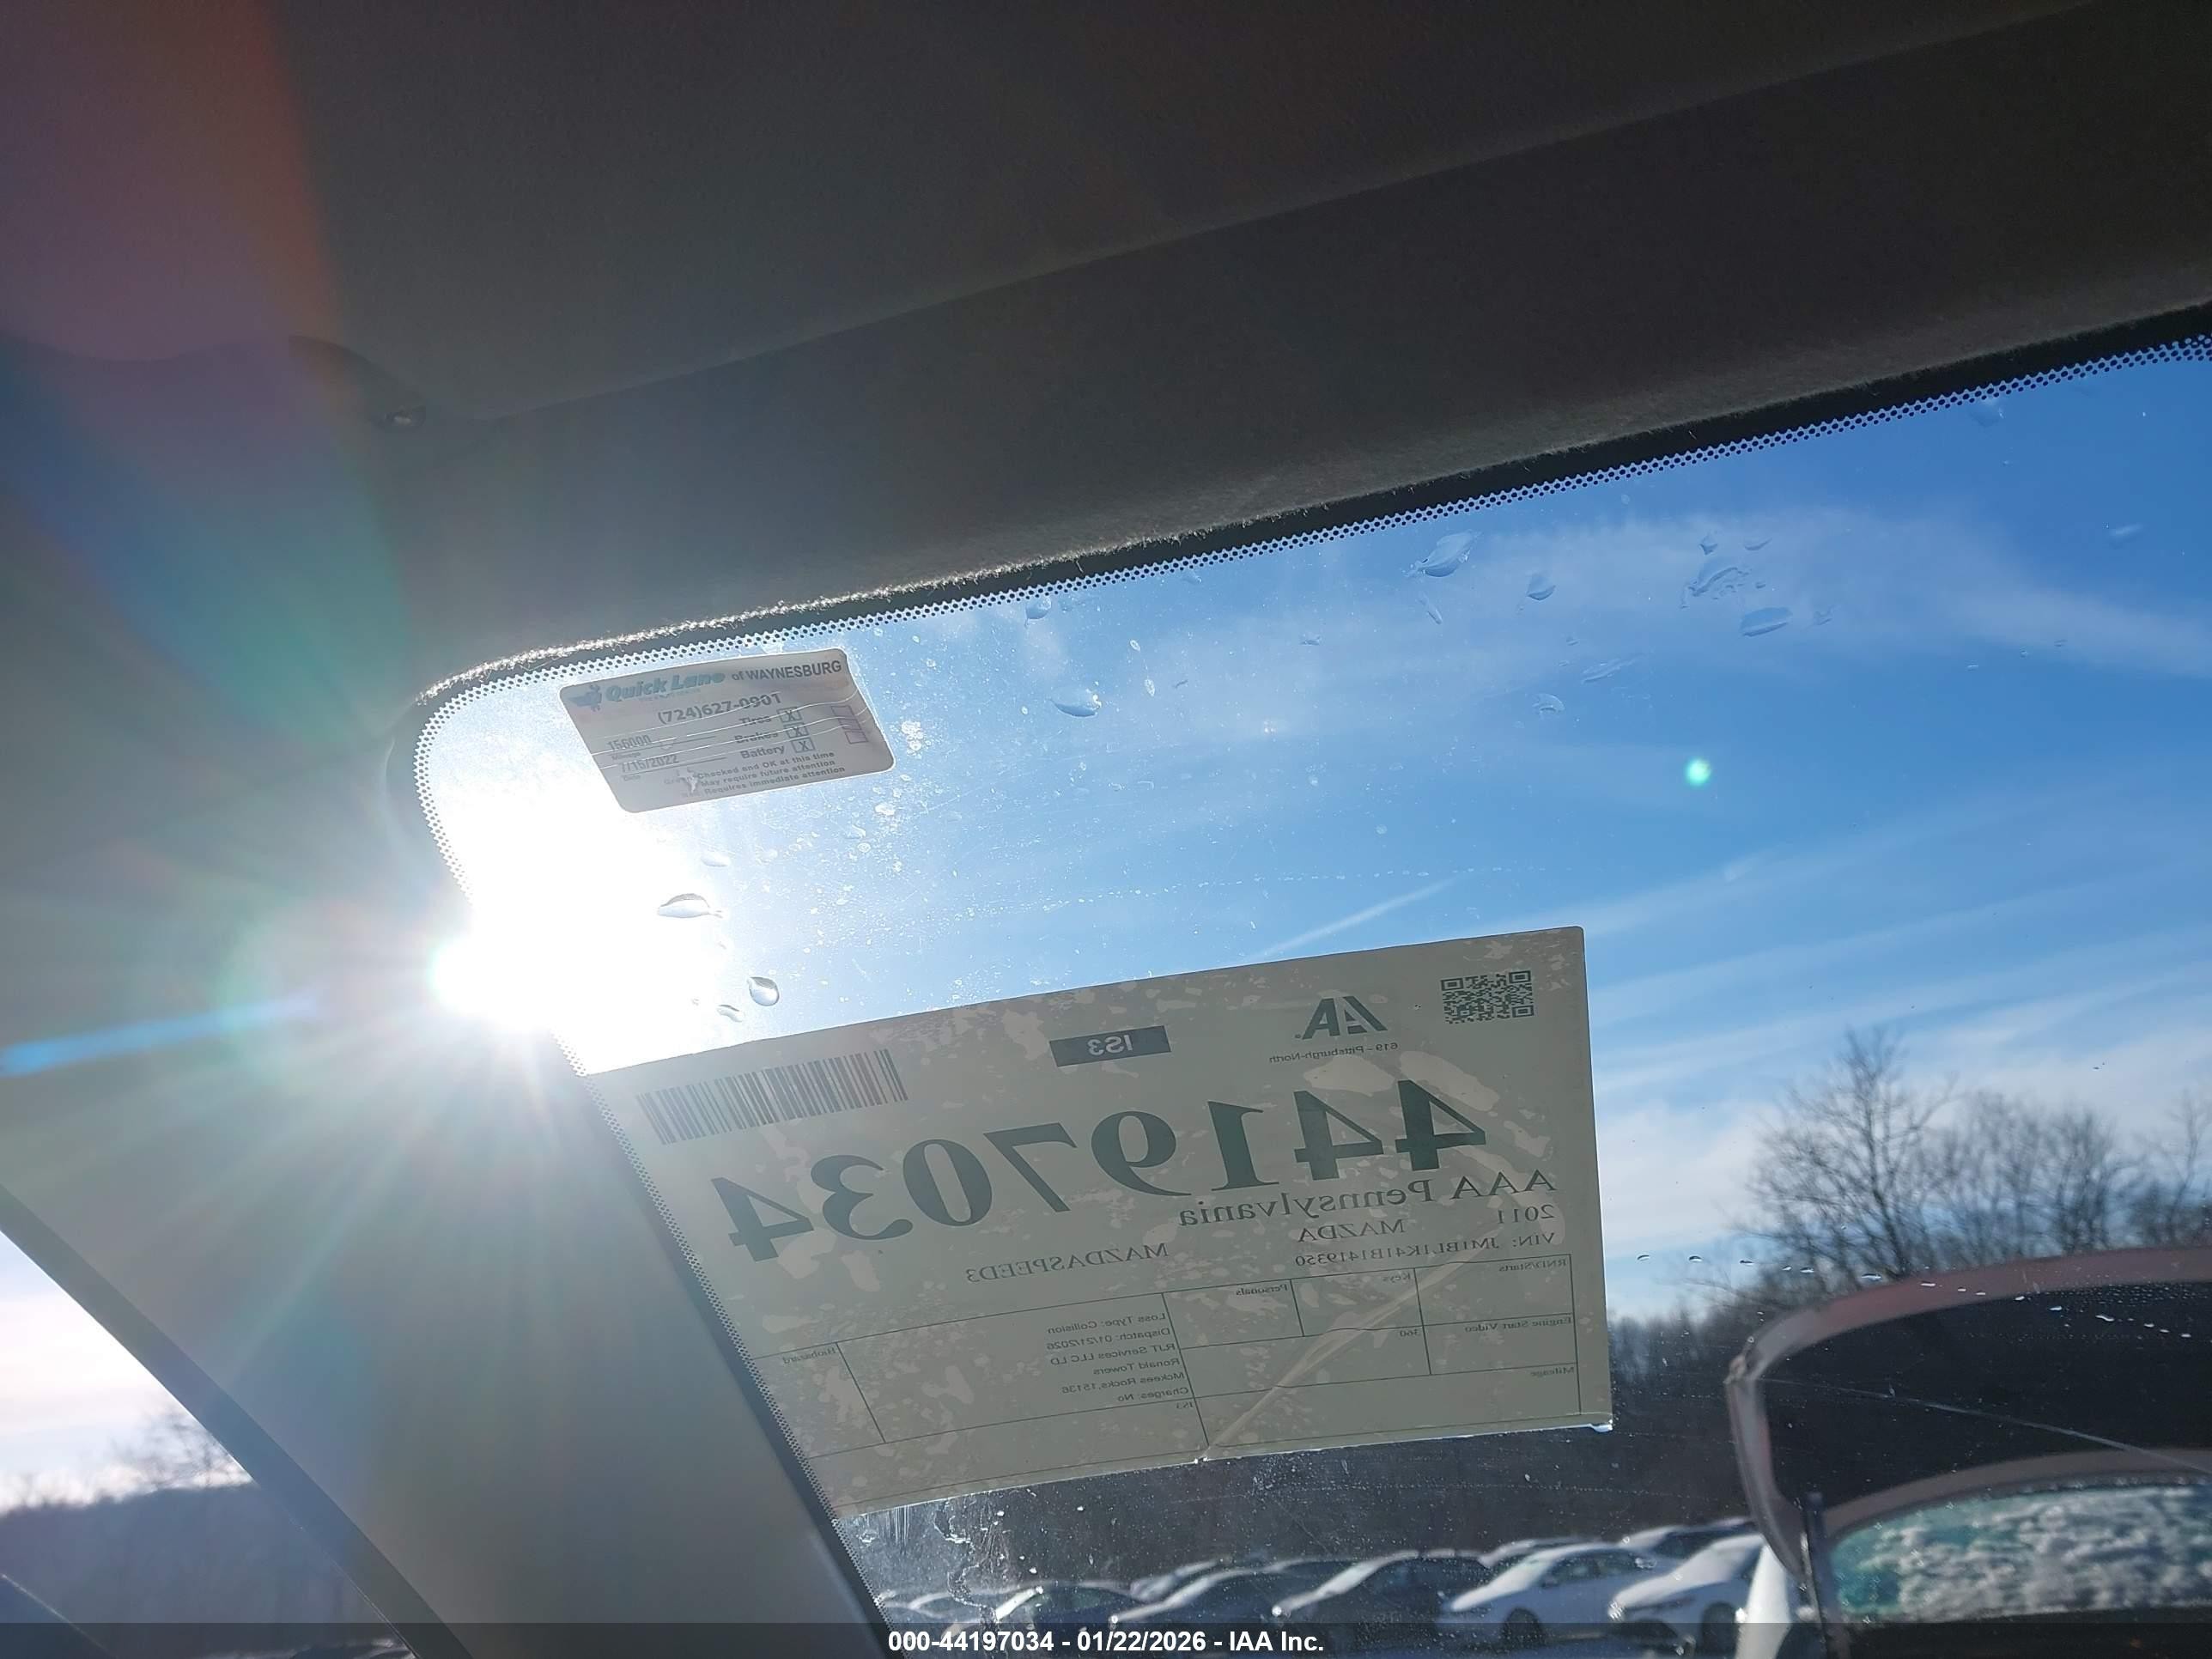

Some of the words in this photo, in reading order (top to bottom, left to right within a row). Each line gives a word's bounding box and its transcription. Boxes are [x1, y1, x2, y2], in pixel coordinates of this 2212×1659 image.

[605, 680, 666, 703] Quick
[671, 671, 726, 691] Lane
[732, 672, 747, 681] of
[745, 659, 842, 681] WAYNESBURG
[658, 692, 781, 725] (724)627-0901
[738, 714, 772, 726] Tires
[607, 734, 652, 751] 156000
[735, 729, 779, 744] Brakes
[697, 766, 739, 780] Checked
[742, 763, 760, 772] and
[792, 754, 811, 763] this
[813, 751, 835, 760] time
[741, 744, 786, 760] Battery
[701, 778, 720, 787] May
[723, 773, 757, 783] require
[760, 768, 789, 778] future
[792, 759, 836, 772] attention
[704, 783, 747, 795] Requires
[749, 775, 799, 787] immediate
[801, 766, 846, 779] attention
